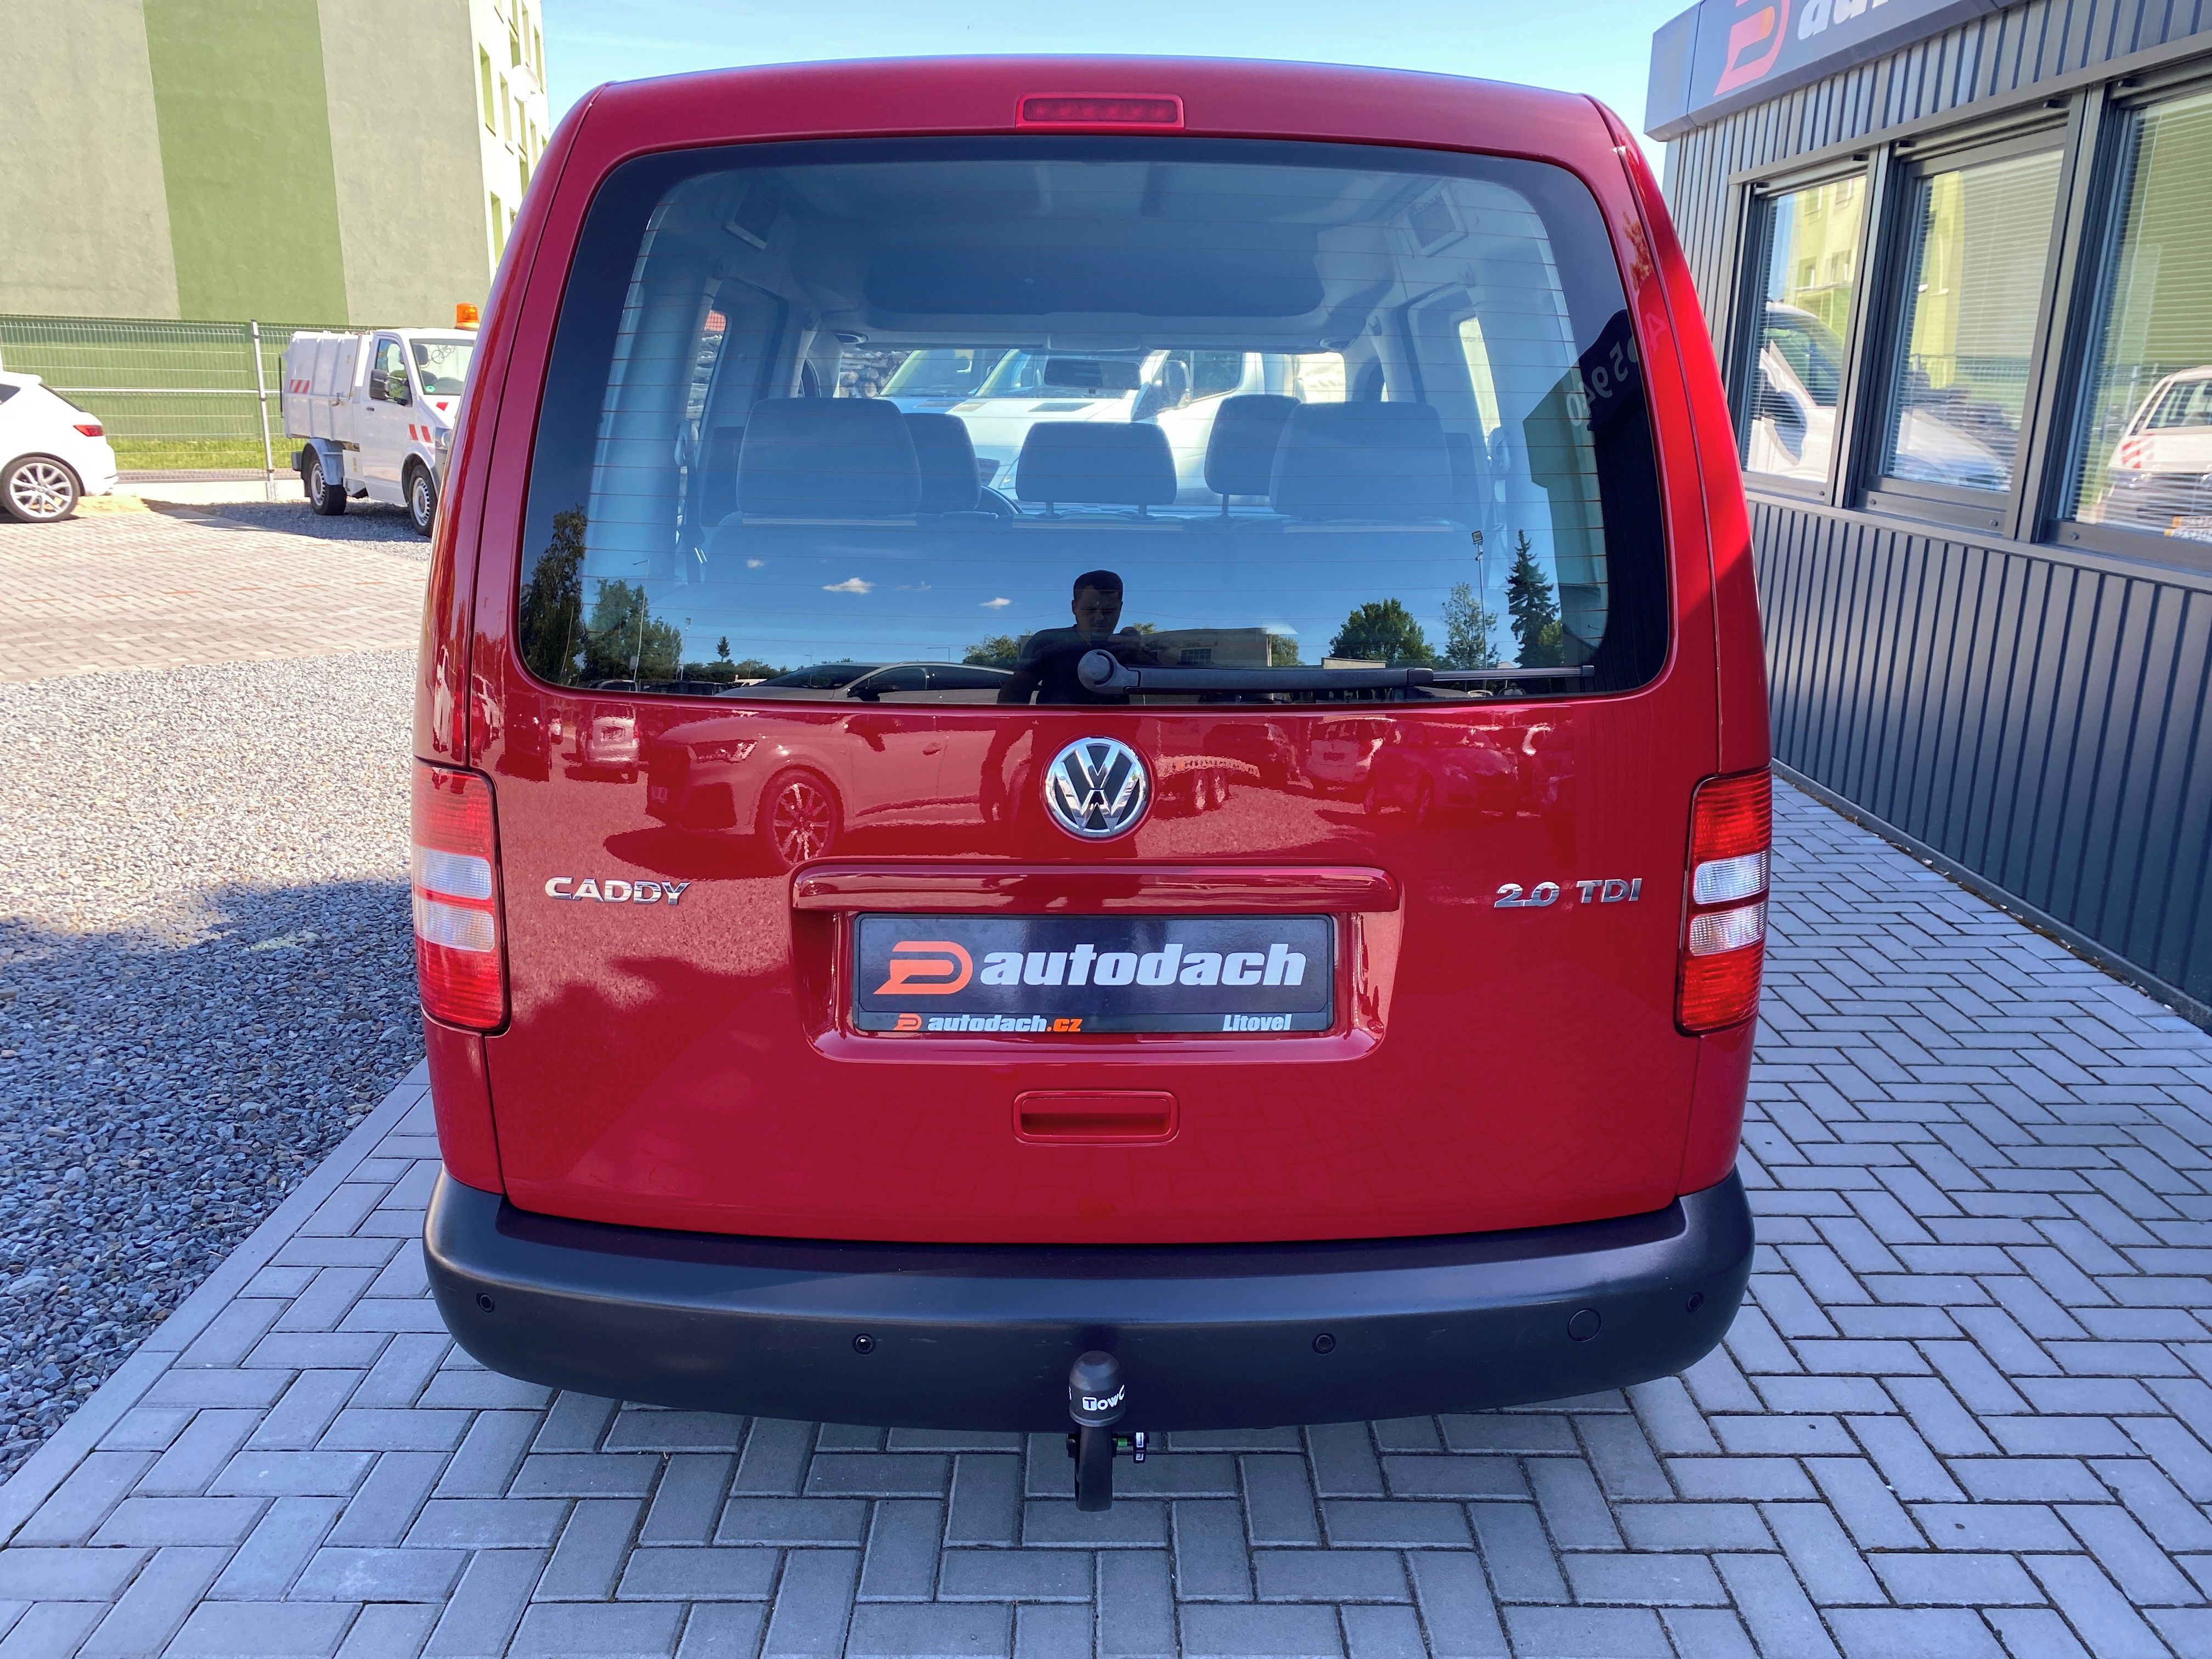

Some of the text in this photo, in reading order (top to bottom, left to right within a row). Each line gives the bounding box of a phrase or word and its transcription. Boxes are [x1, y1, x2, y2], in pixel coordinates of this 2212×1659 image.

[545, 876, 691, 905] CADDY
[1494, 878, 1643, 908] 2.0 TDI
[980, 943, 1307, 986] autodach
[927, 1014, 1084, 1032] autodach.cz
[1222, 1013, 1293, 1032] Litovel
